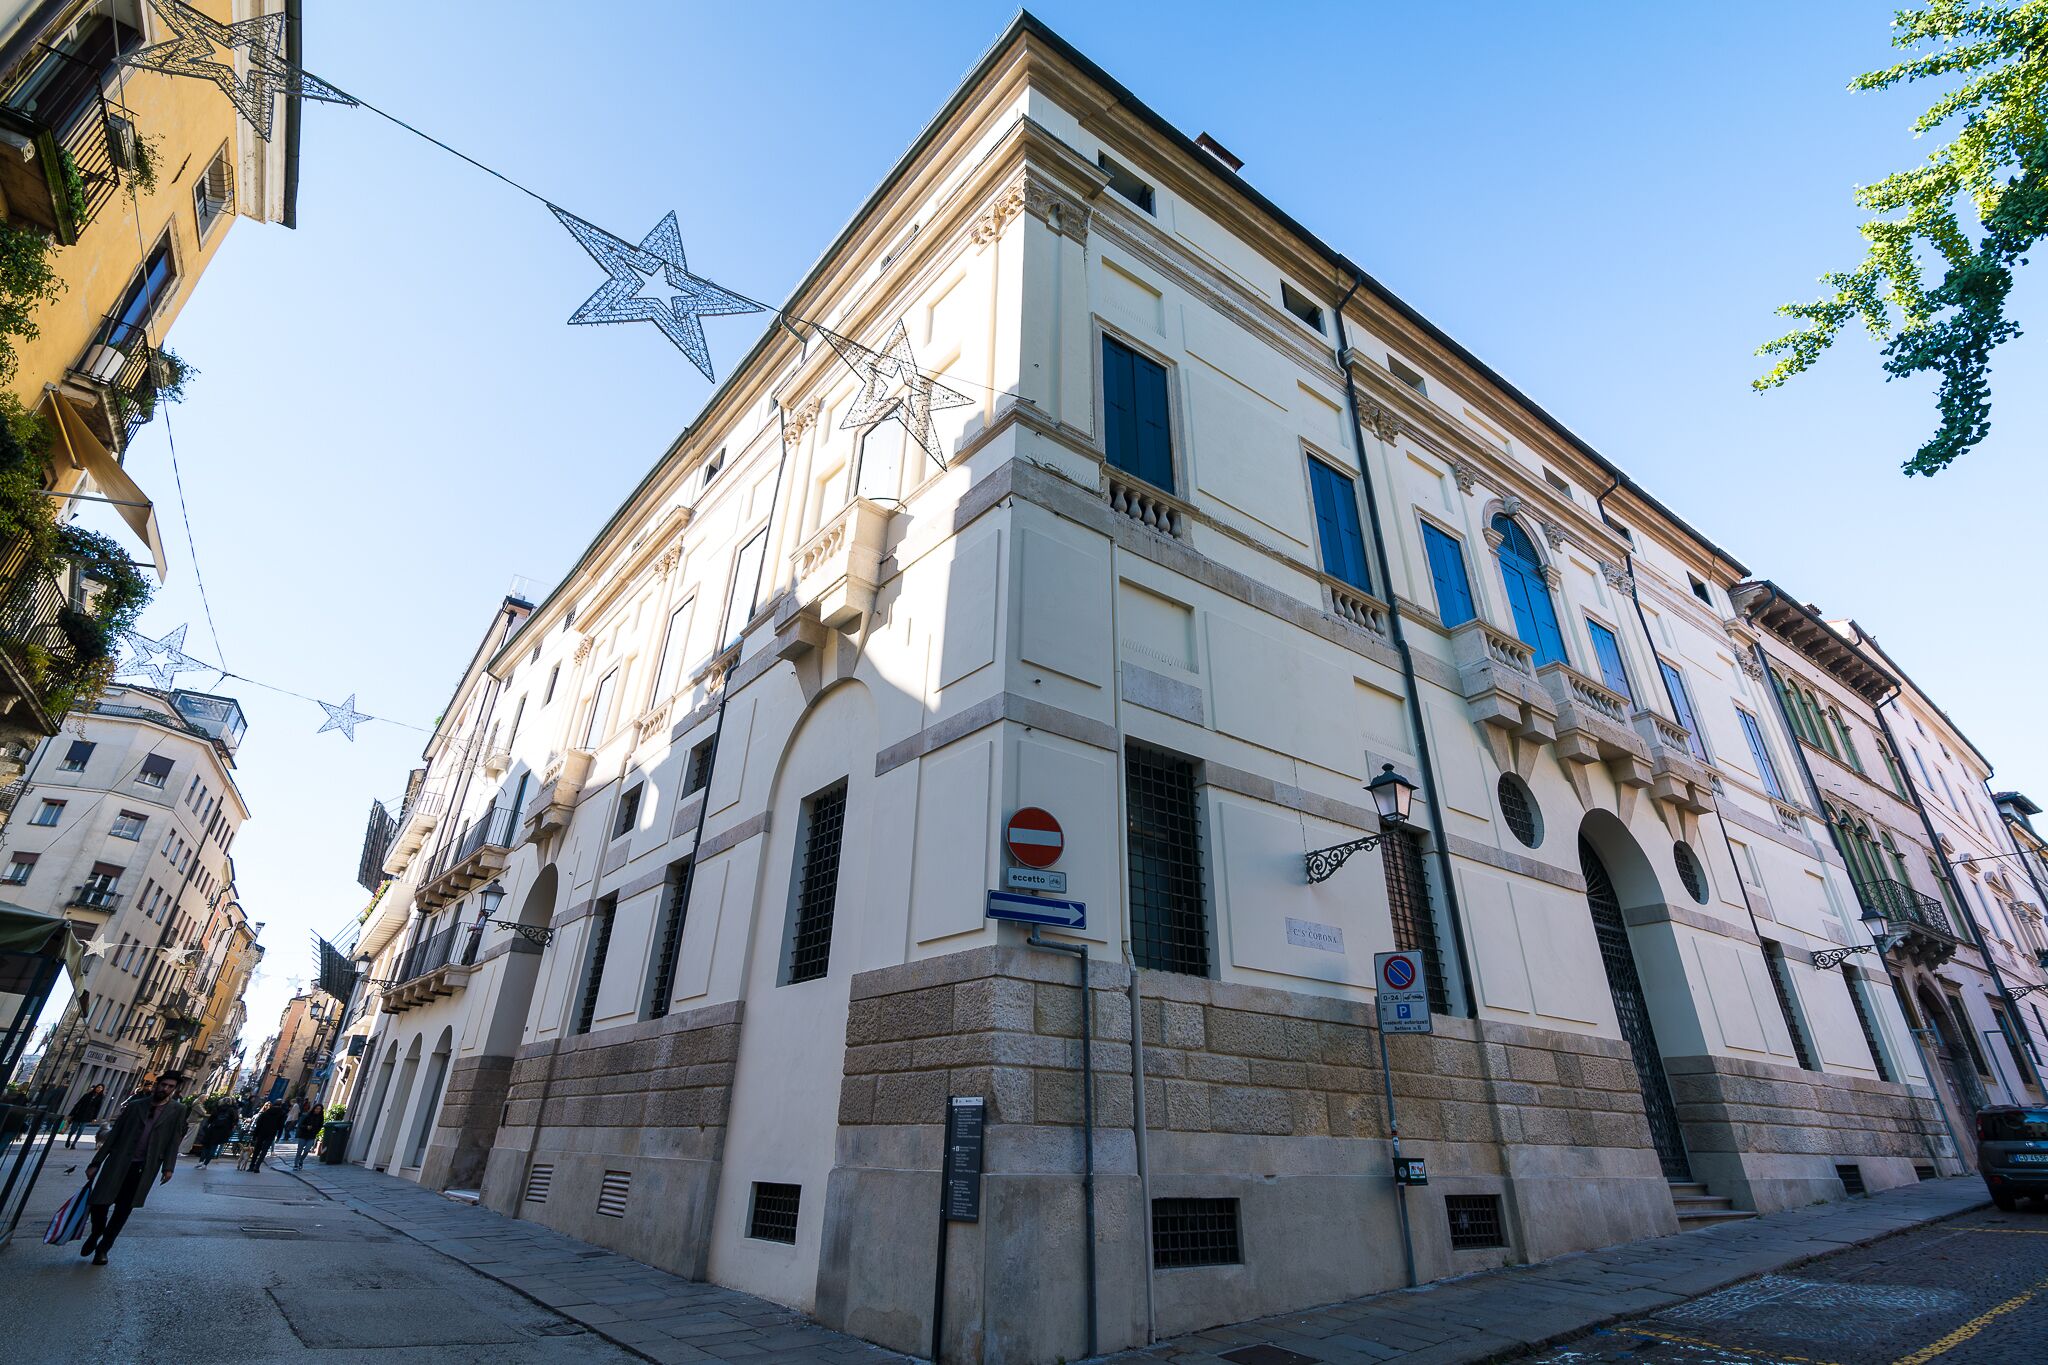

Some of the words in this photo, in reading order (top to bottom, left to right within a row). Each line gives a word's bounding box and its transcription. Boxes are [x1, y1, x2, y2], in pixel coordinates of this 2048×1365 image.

[1012, 874, 1045, 884] eccetto
[1308, 931, 1337, 943] CORONA
[1399, 1006, 1408, 1017] P
